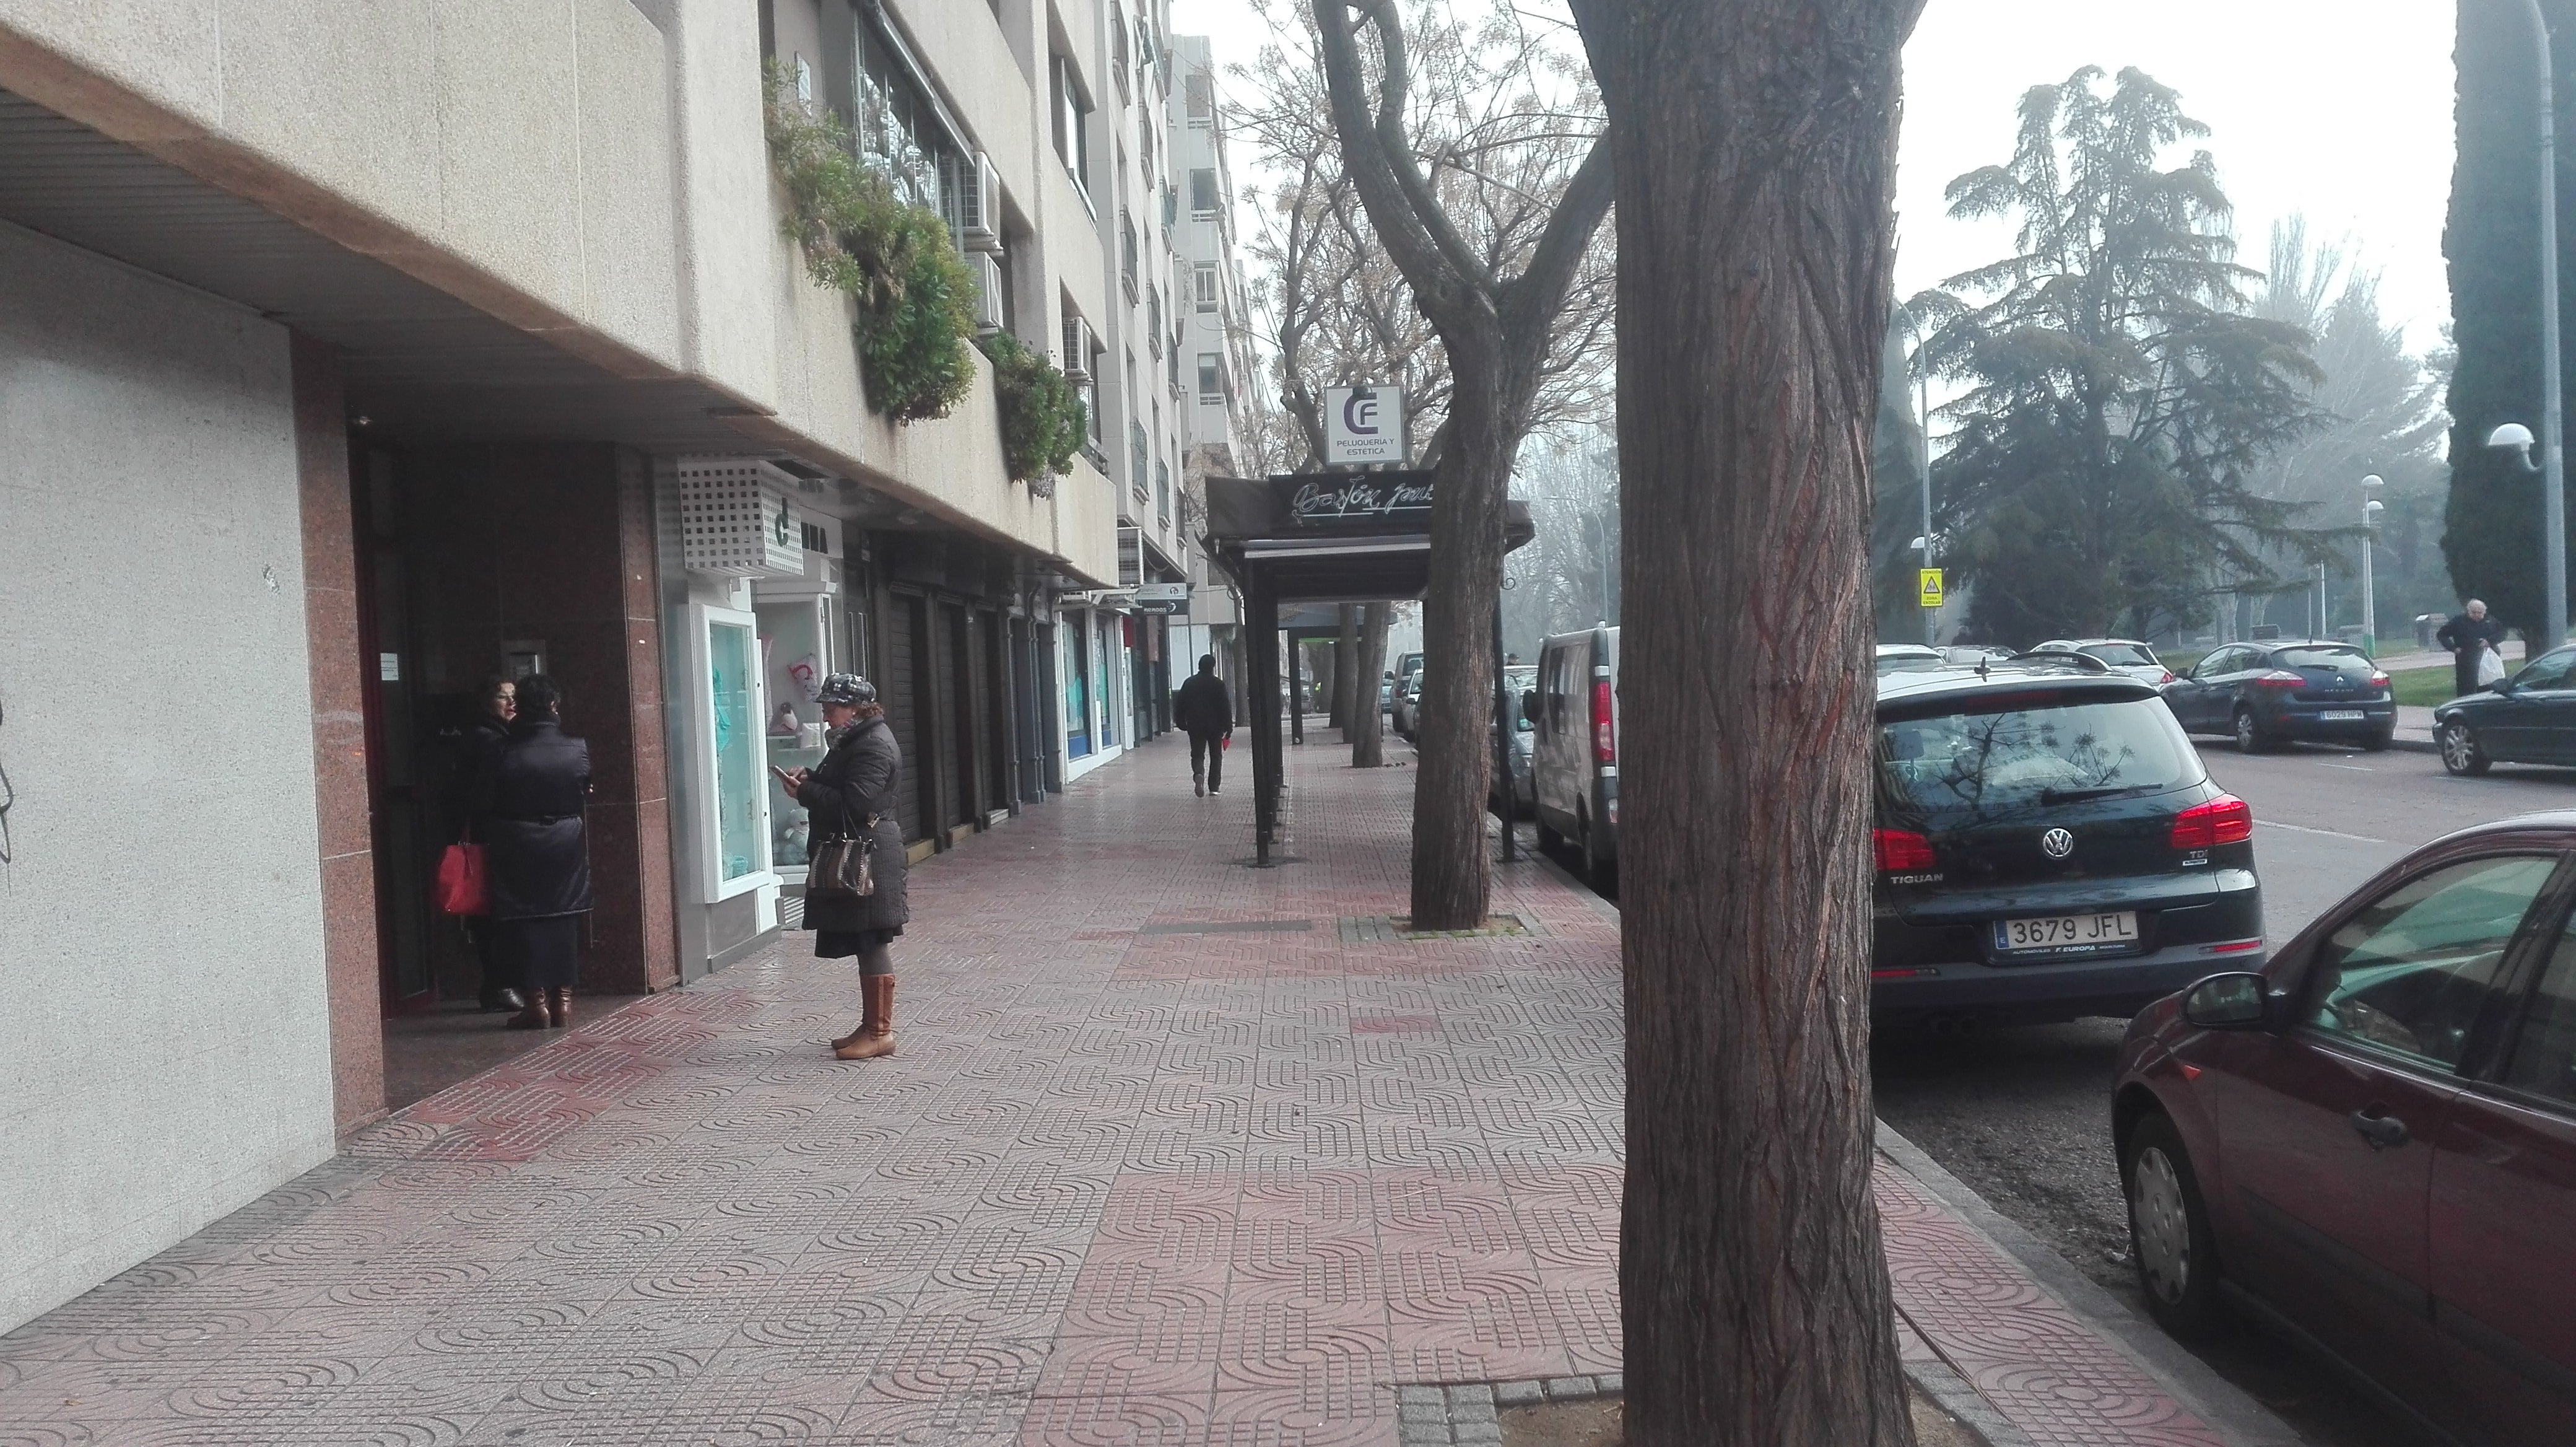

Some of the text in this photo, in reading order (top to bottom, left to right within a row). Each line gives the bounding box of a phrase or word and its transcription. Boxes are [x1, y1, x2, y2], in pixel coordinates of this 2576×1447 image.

[1337, 437, 1387, 447] PELUQUERÍA
[1347, 447, 1385, 455] ESTÉTICA
[2189, 849, 2208, 859] TDI
[1890, 873, 1943, 885] TIGUAN
[2013, 914, 2132, 944] 3679 JFL
